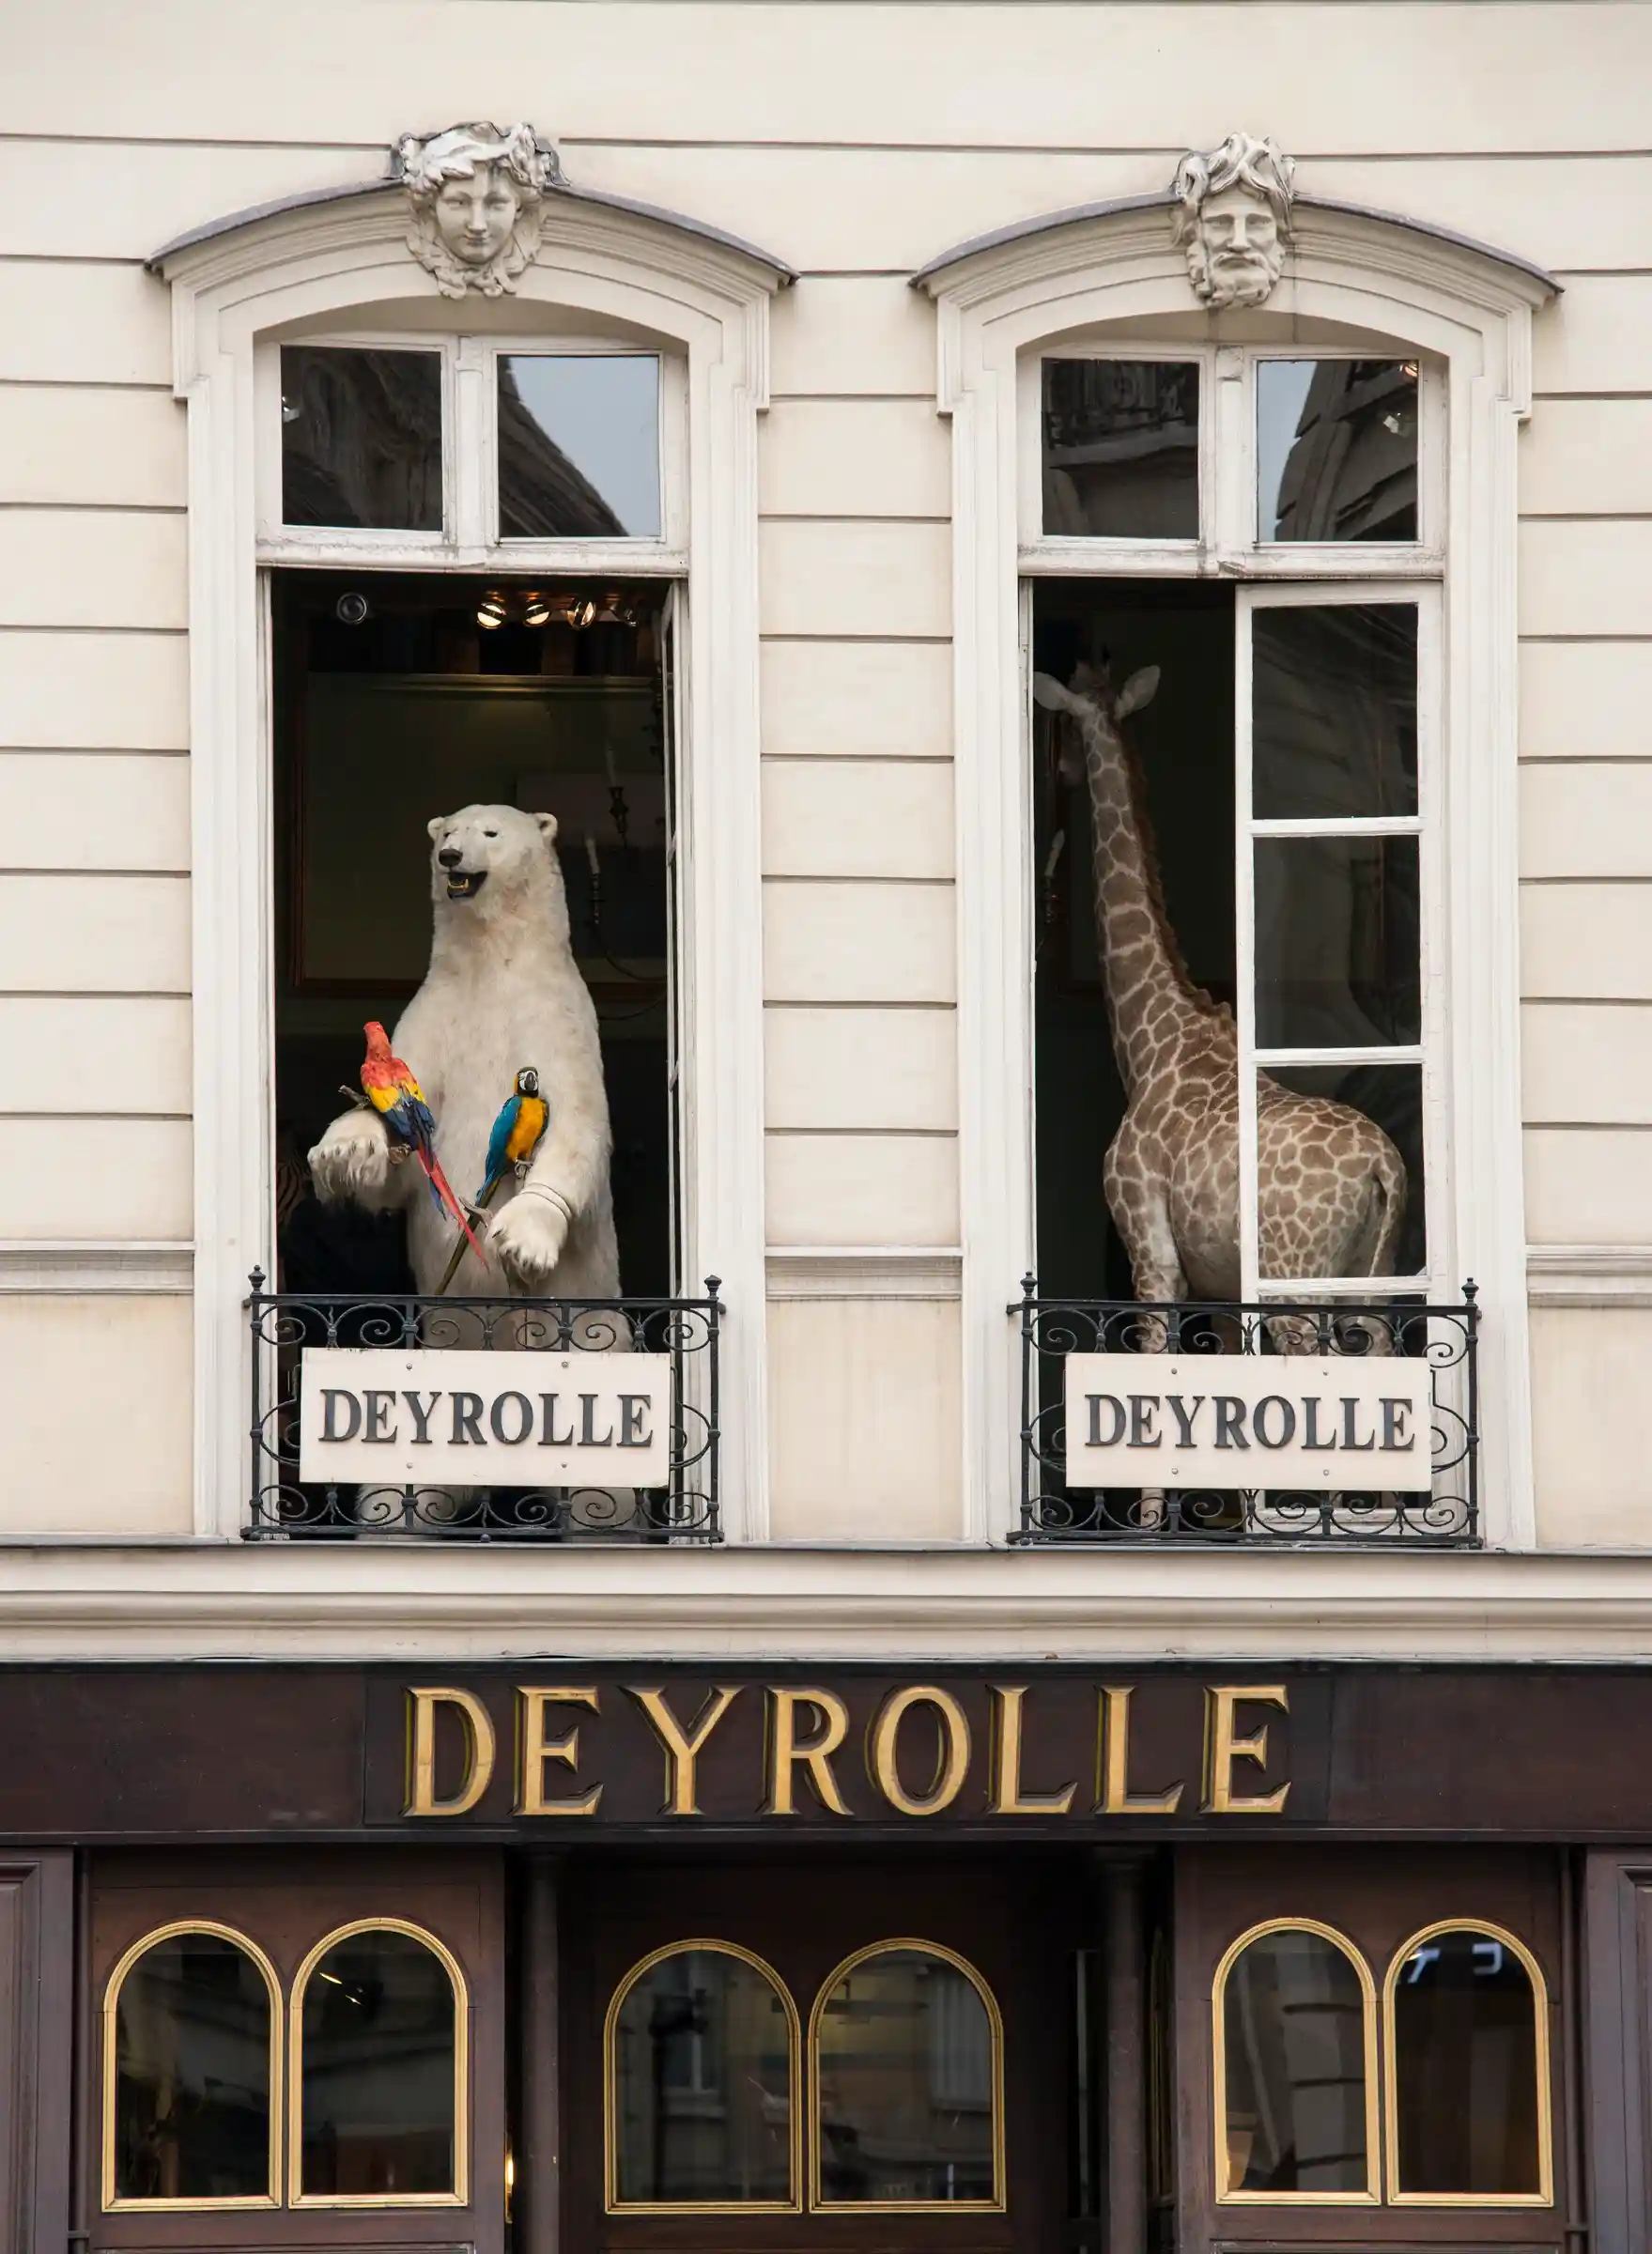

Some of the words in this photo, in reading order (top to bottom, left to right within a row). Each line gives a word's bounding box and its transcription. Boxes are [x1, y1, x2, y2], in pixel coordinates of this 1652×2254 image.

[318, 1389, 654, 1448] DEYROLLE
[1084, 1394, 1415, 1452] DEYROLLE
[402, 1685, 1291, 1816] DEYROLLE
